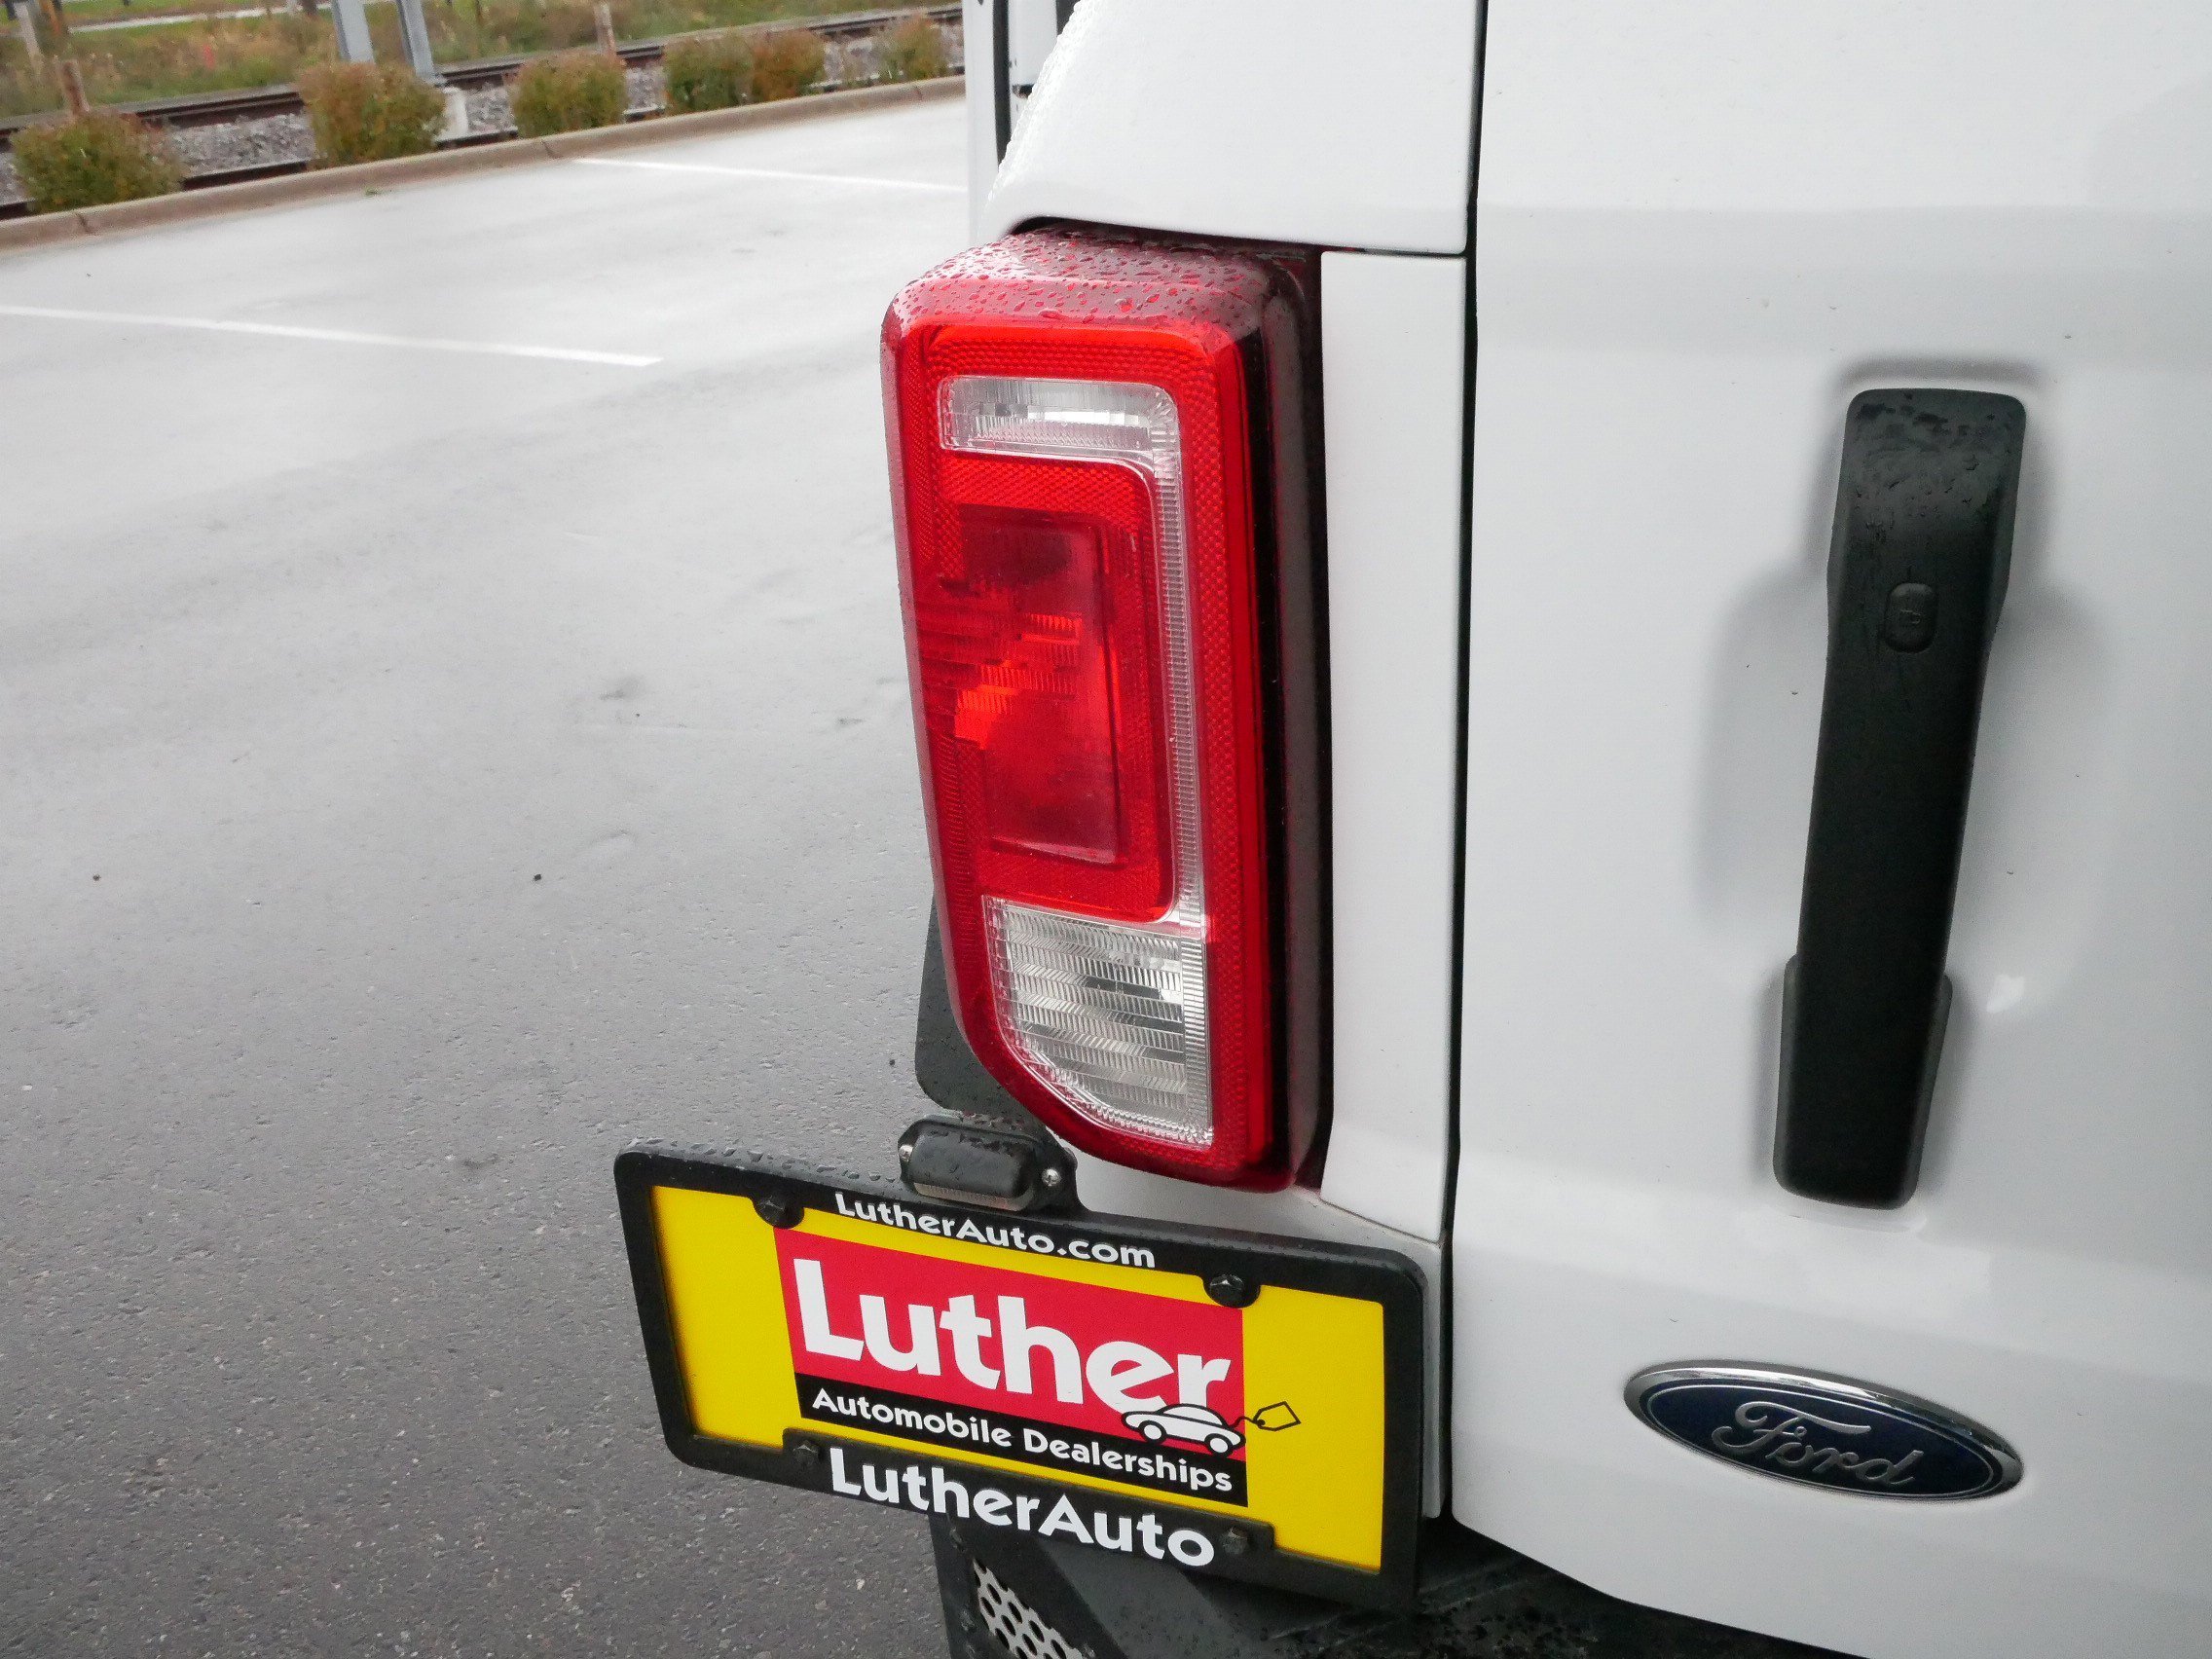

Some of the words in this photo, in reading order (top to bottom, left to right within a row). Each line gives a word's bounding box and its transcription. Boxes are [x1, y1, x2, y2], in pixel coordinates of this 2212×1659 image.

[835, 1193, 1156, 1269] LutherAuto.com
[793, 1259, 1231, 1415] Luther
[811, 1387, 1013, 1449] Automobile
[1023, 1428, 1233, 1493] Dealerships
[1711, 1400, 1924, 1486] Ford
[829, 1447, 1216, 1568] LutherAuto
